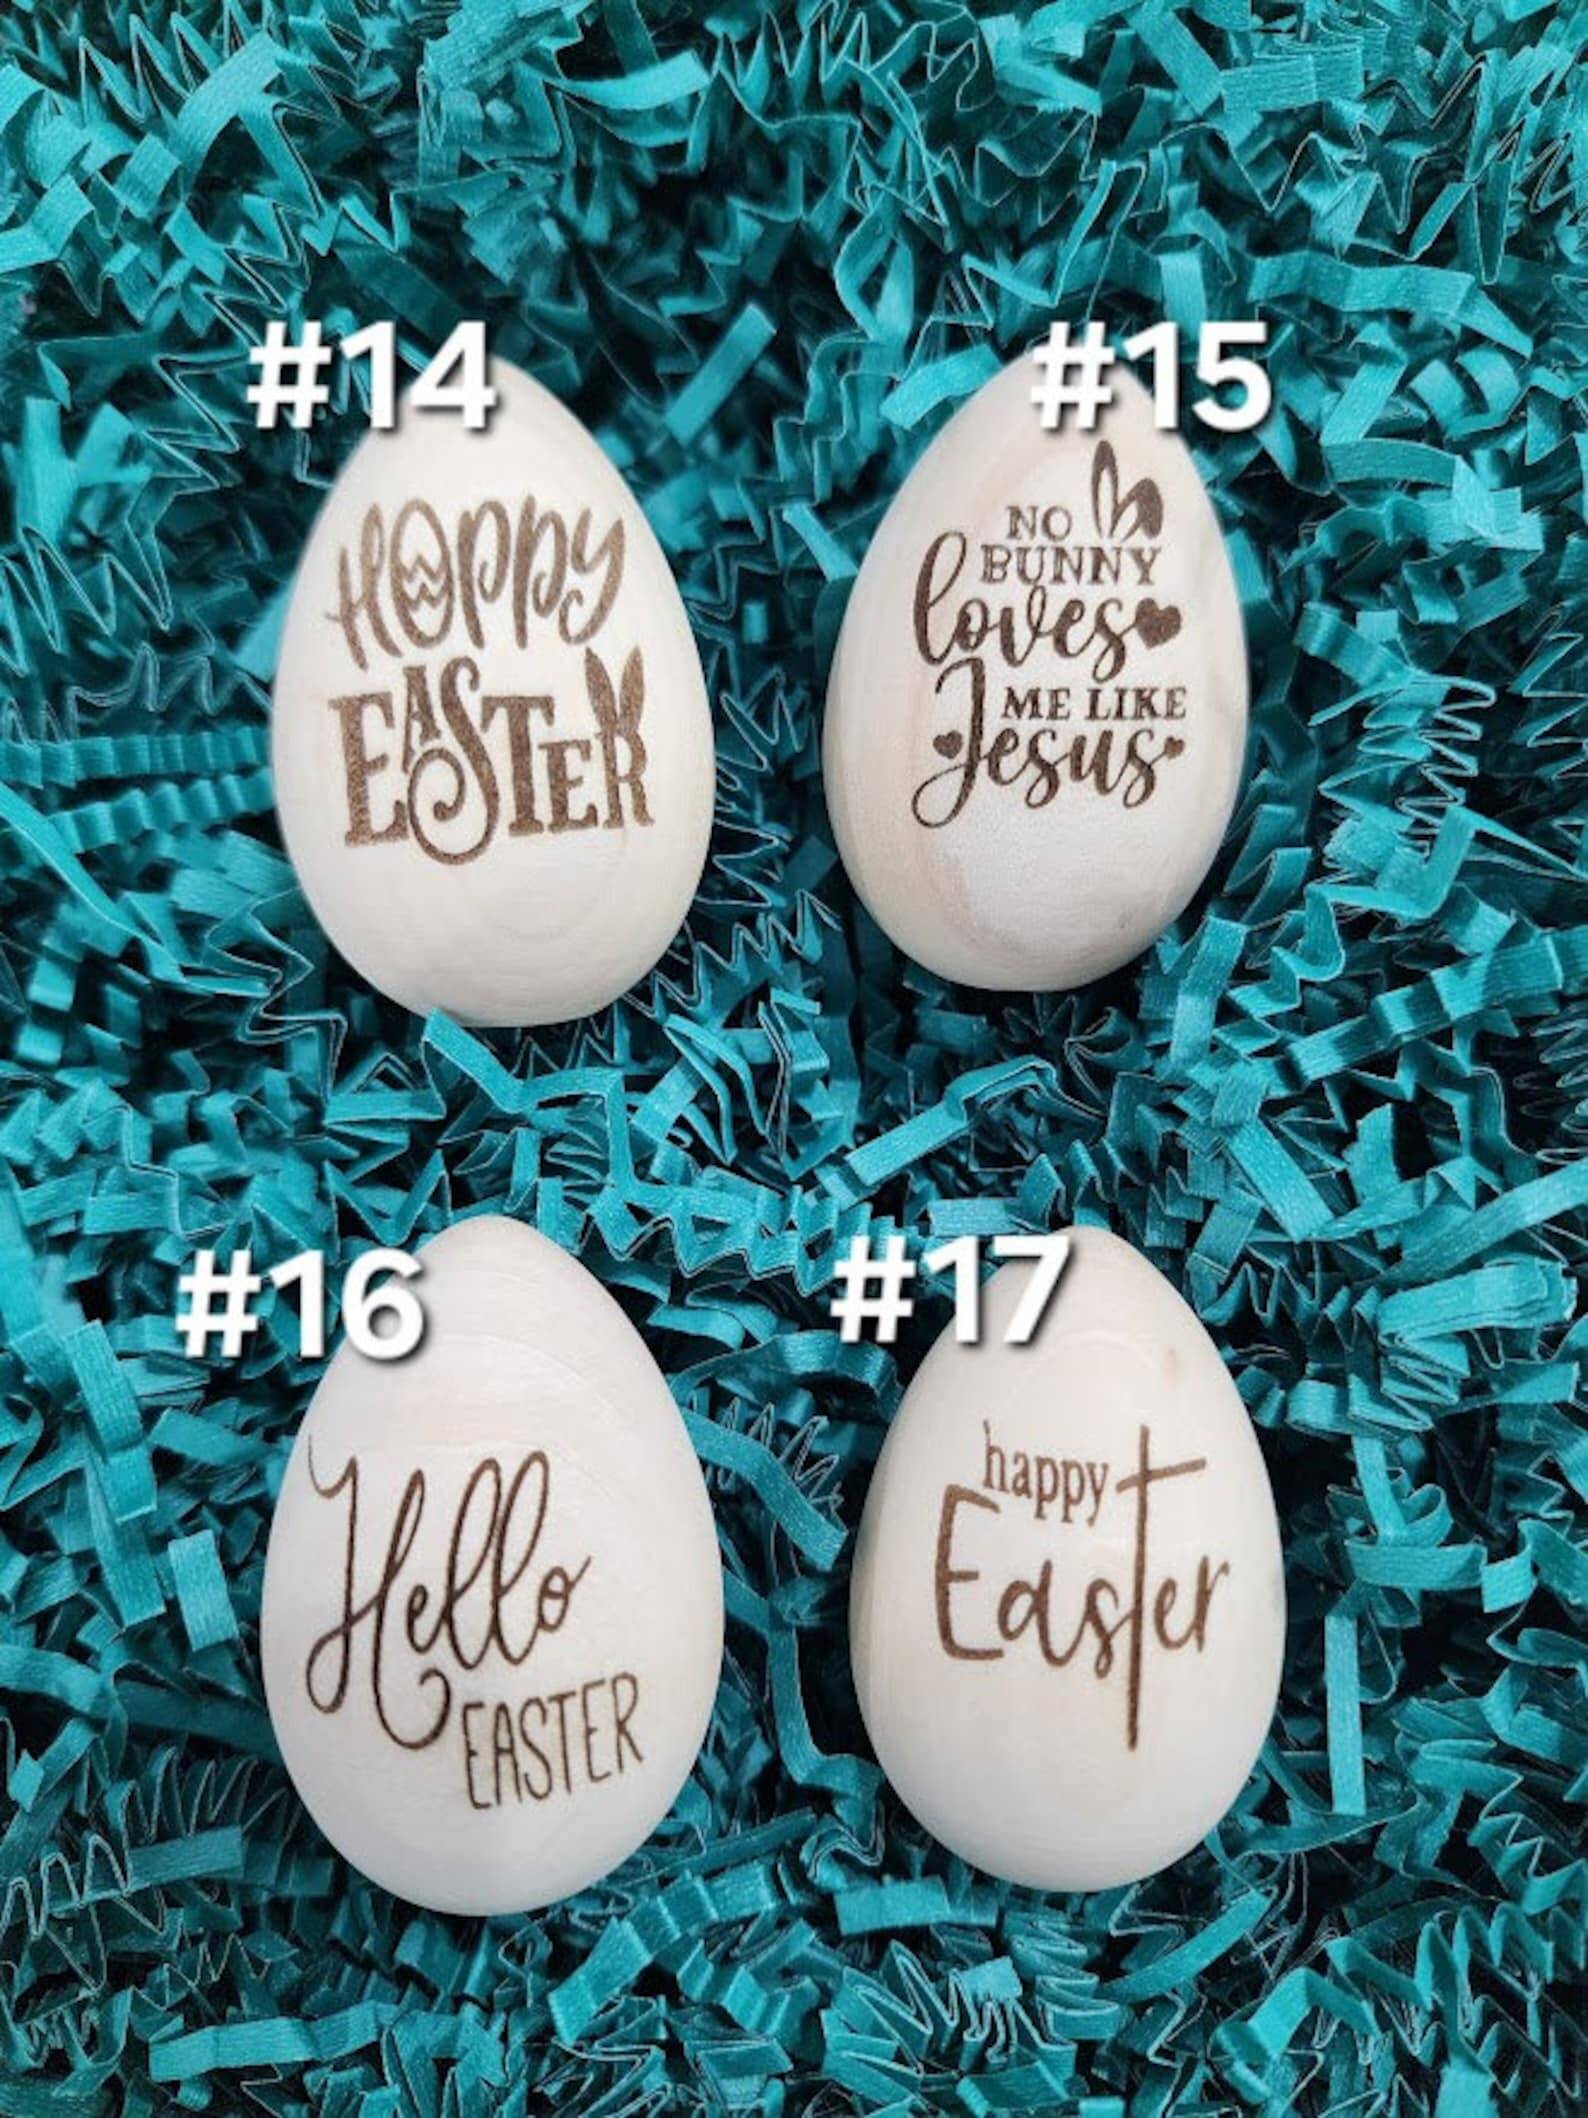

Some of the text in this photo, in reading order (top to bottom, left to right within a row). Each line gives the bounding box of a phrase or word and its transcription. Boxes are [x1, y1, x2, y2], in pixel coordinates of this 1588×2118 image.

[979, 545, 1161, 586] BUNNY
[1006, 505, 1073, 541] NO
[913, 531, 1139, 682] loves
[911, 657, 1167, 828] Jesus
[1001, 686, 1187, 720] ME LIKE
[982, 1420, 1109, 1526] happy
[306, 1433, 592, 1750] Hello
[934, 1425, 1229, 1752] Easter
[462, 1671, 644, 1811] EASTER
